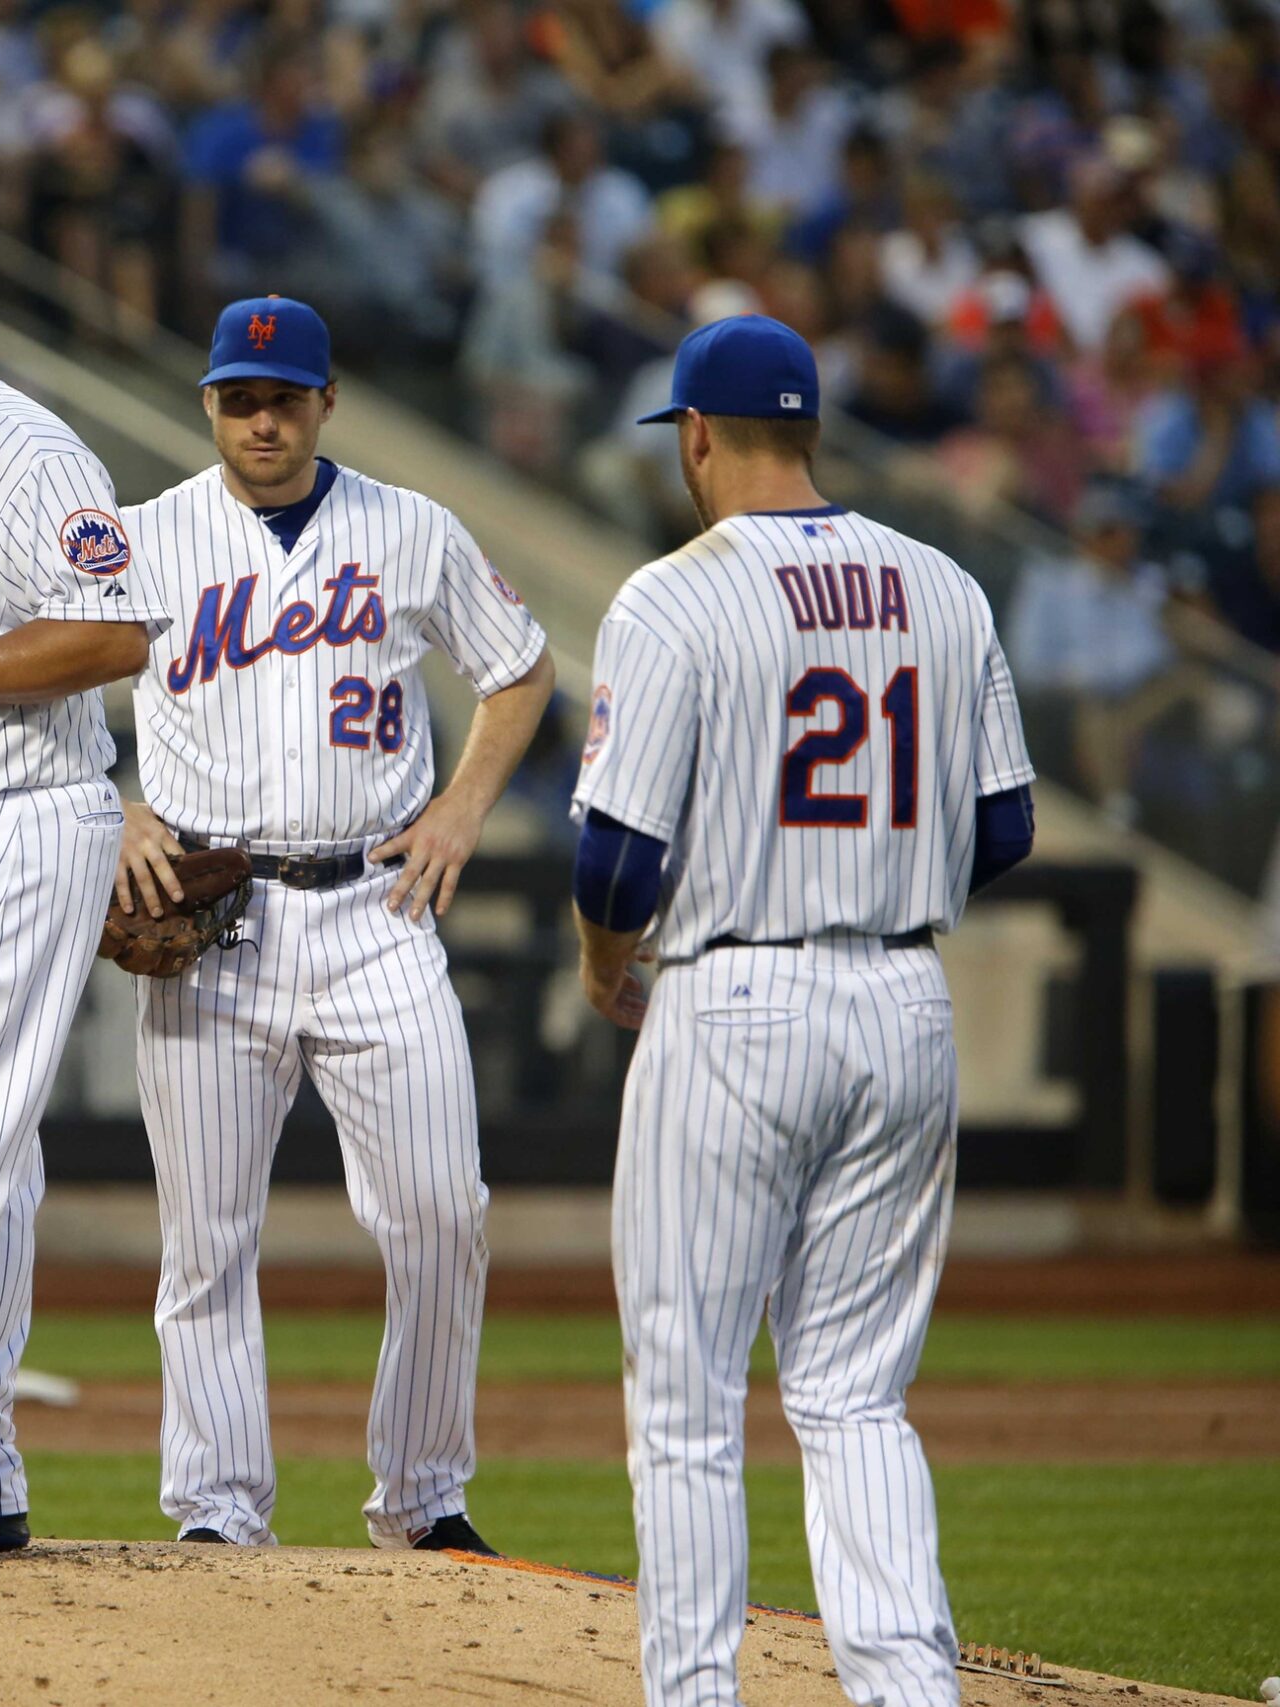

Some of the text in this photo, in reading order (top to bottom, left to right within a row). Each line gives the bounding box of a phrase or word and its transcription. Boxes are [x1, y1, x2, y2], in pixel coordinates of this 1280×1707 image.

[77, 534, 119, 562] Mets
[167, 562, 387, 694] Mets
[775, 563, 909, 634] DUDA
[329, 675, 404, 754] 28
[779, 666, 919, 829] 21
